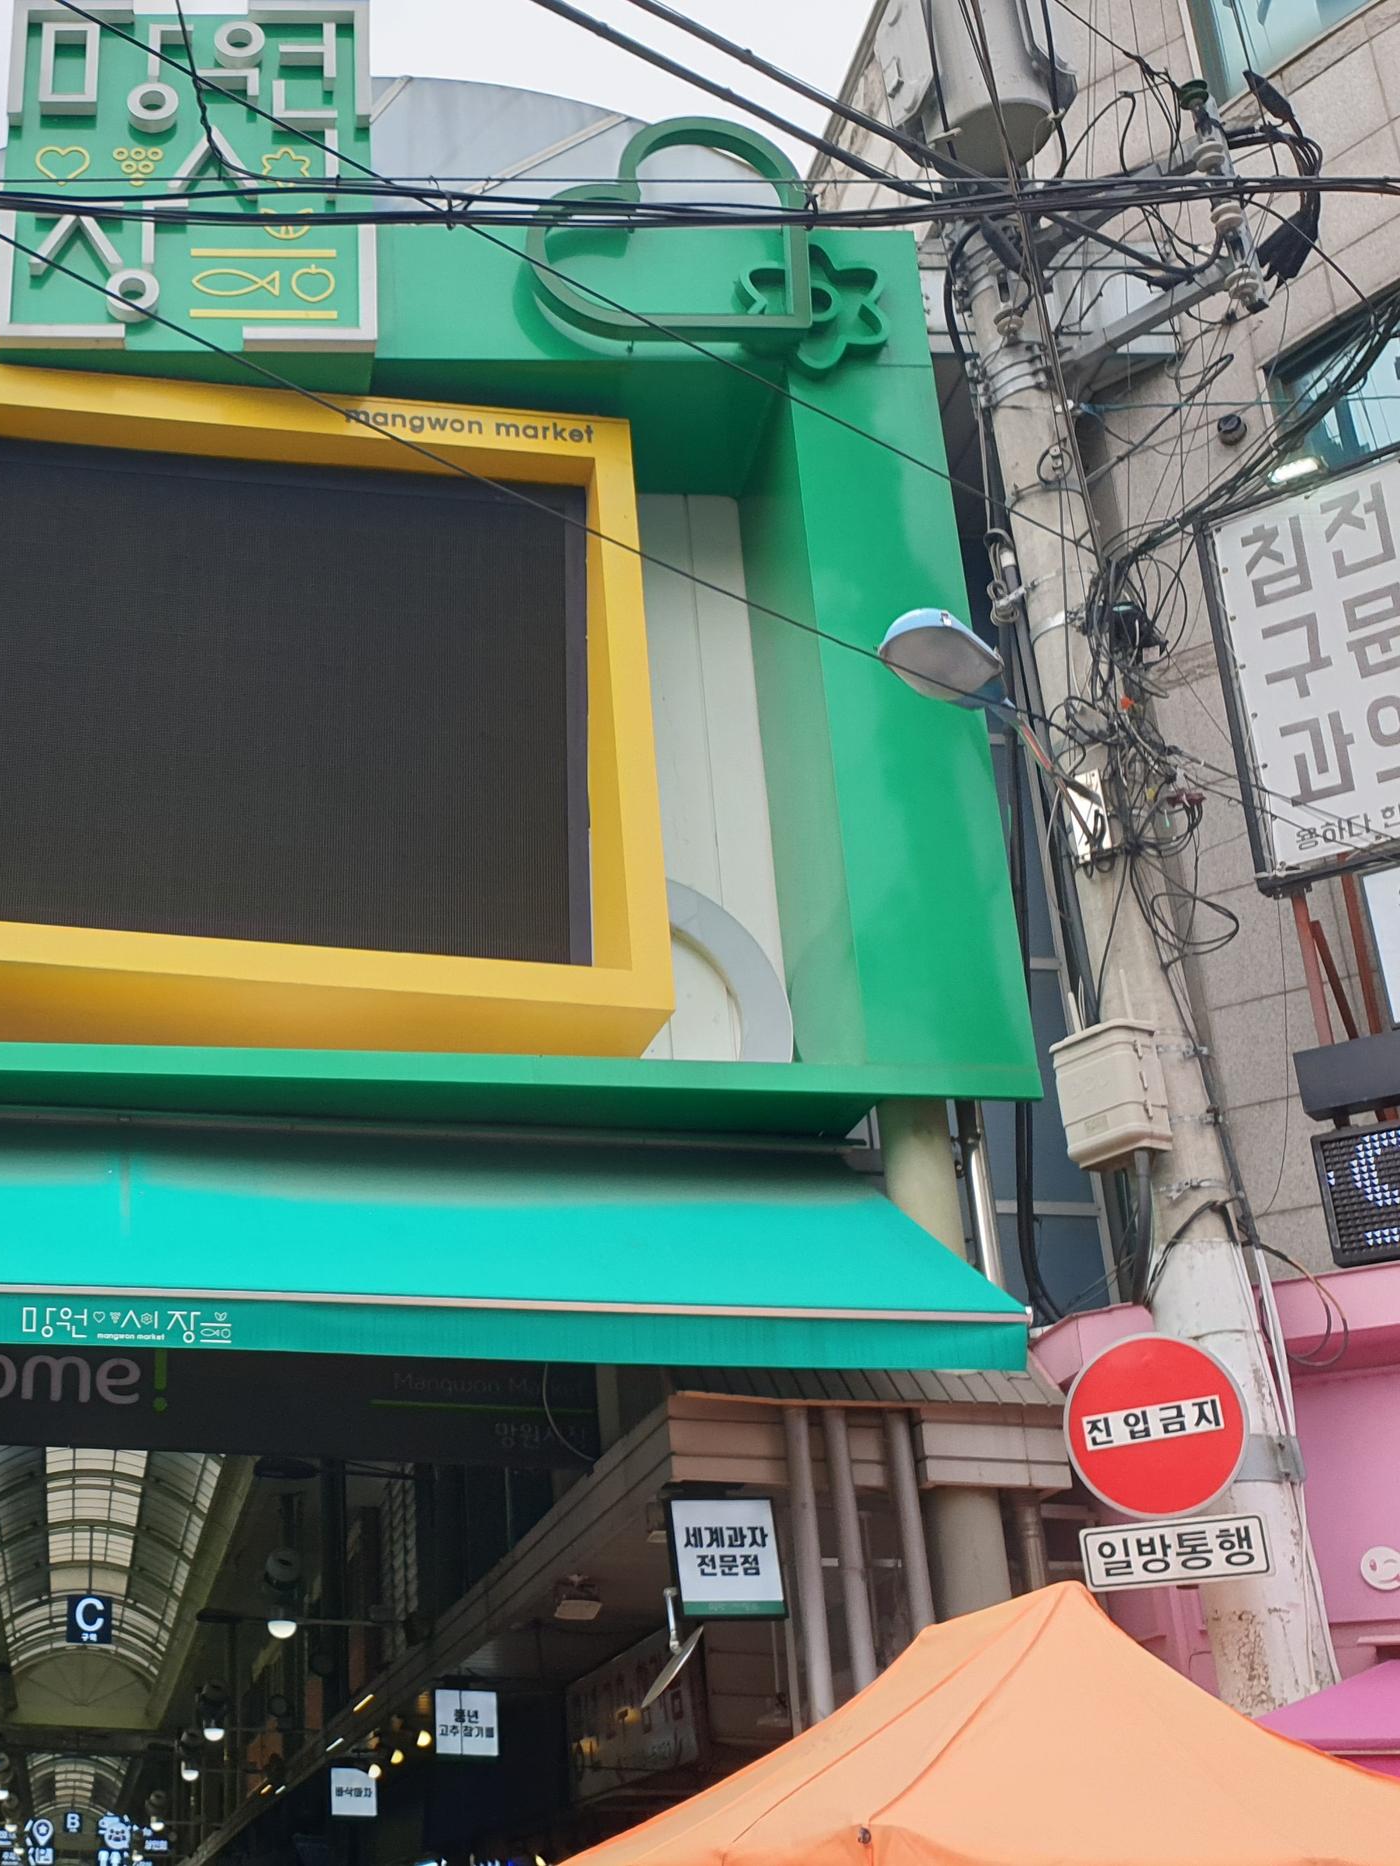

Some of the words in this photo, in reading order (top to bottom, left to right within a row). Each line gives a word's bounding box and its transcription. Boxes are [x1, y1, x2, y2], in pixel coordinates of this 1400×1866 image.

[38, 20, 338, 133] 망원
[345, 407, 484, 434] mangwon
[495, 421, 595, 444] market
[1296, 812, 1372, 851] 용하다
[97, 1331, 135, 1342] mangwon
[137, 1333, 165, 1342] market
[1085, 1398, 1221, 1447] 진입금지
[683, 1525, 769, 1549] 세계과자
[1097, 1525, 1256, 1578] 일방통행
[696, 1554, 761, 1577] 전문점
[75, 1597, 105, 1632] C
[66, 1813, 80, 1828] B
